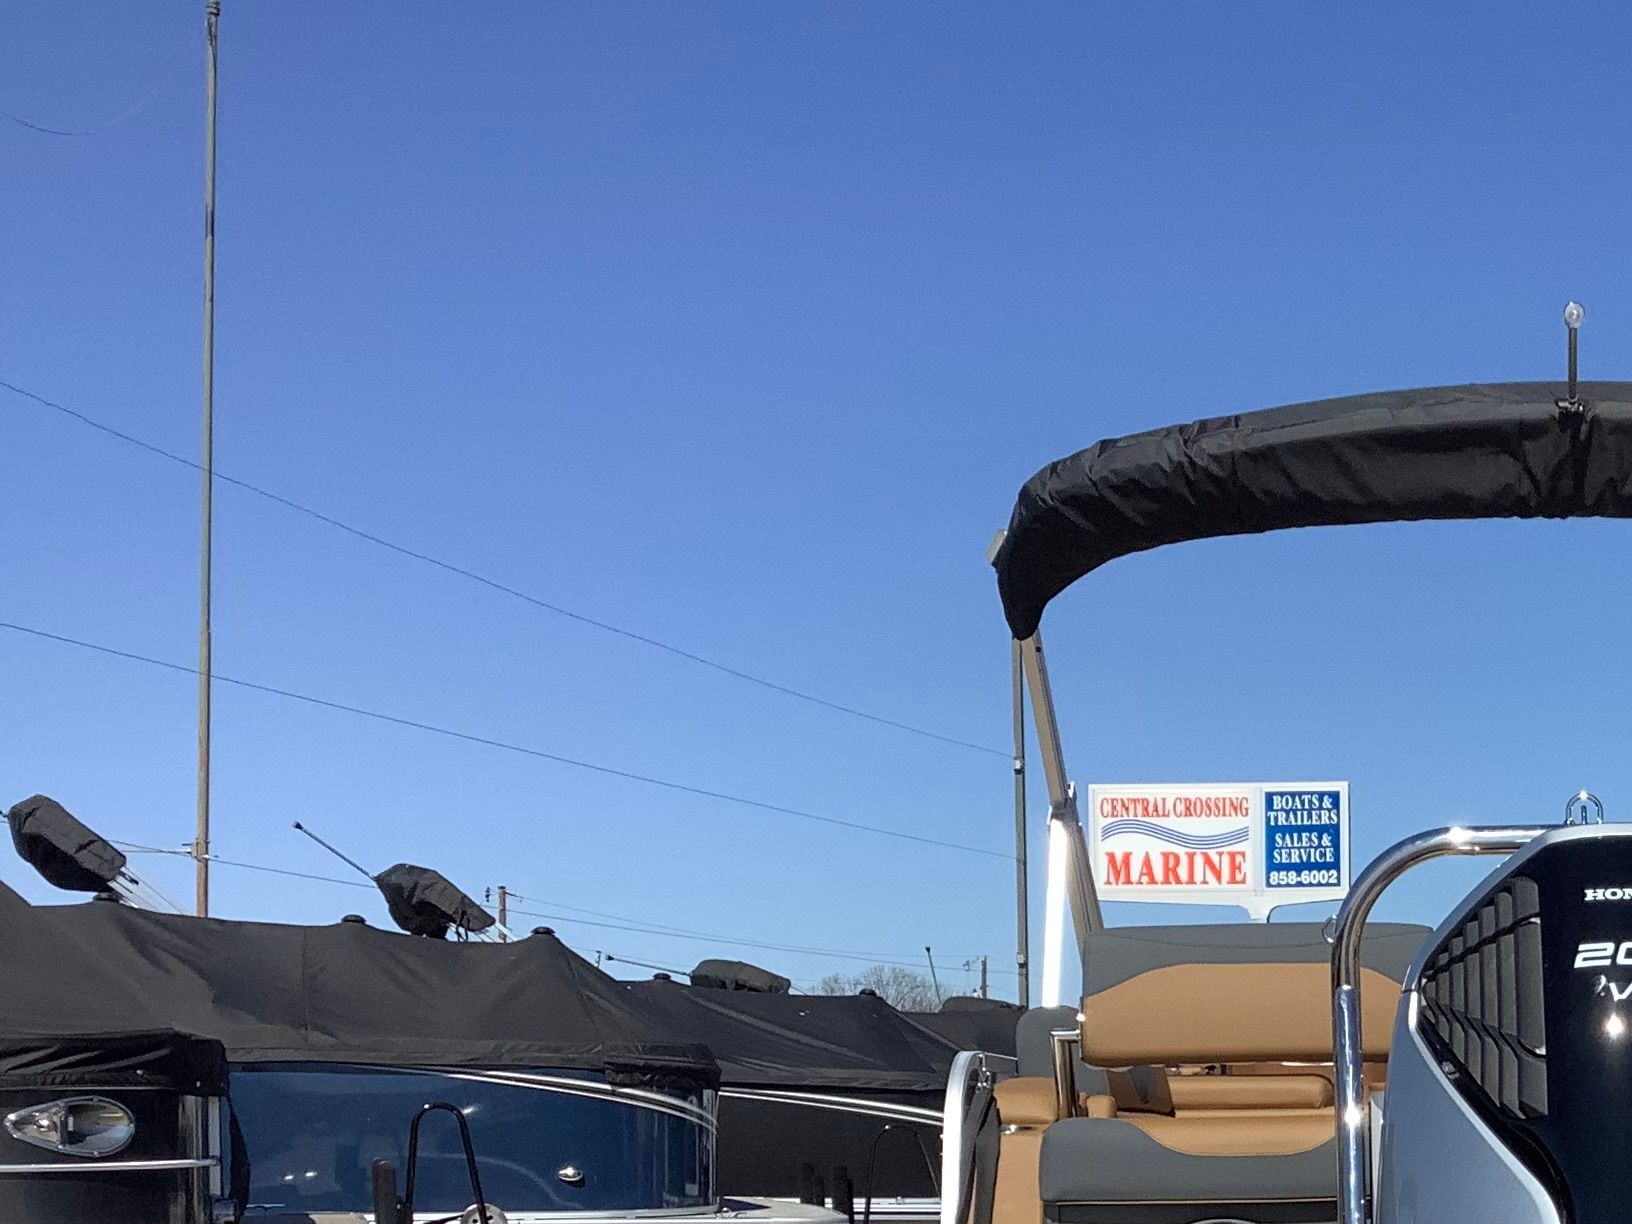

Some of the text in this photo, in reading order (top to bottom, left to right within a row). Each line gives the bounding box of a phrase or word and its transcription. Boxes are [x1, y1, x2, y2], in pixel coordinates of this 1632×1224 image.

[1100, 796, 1249, 818] CENTRAL CROSSING
[1272, 794, 1333, 810] BOATS &
[1267, 809, 1338, 826] TRAILERS
[1275, 832, 1332, 848] SALES &
[1273, 848, 1335, 864] SERVICE
[1103, 851, 1247, 886] MARINE
[1268, 870, 1338, 886] 858-6002
